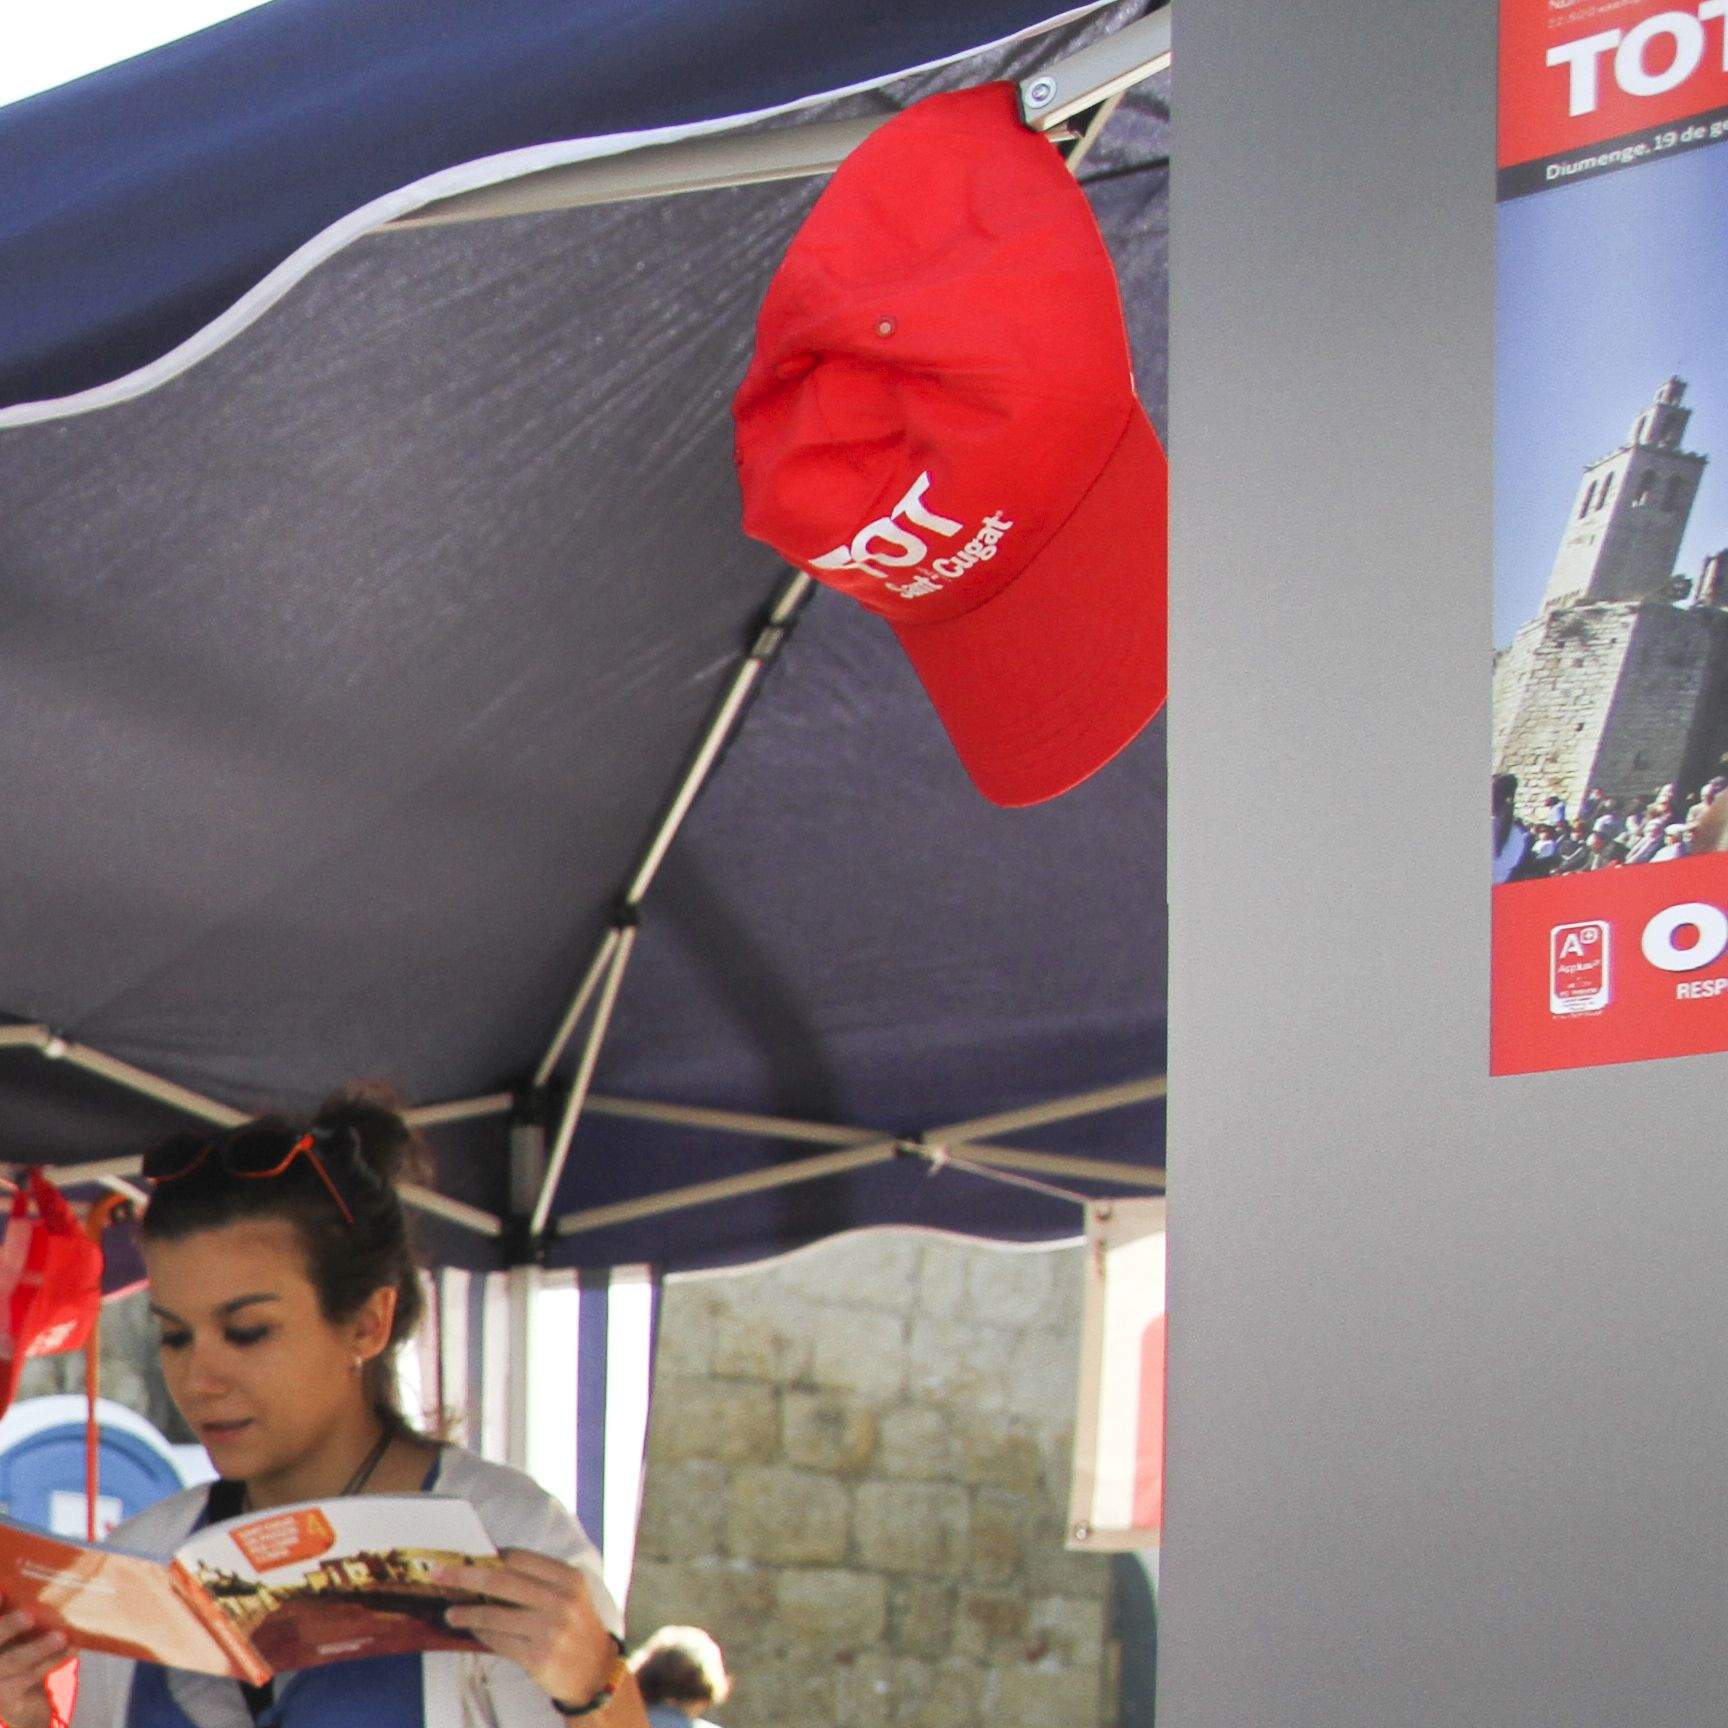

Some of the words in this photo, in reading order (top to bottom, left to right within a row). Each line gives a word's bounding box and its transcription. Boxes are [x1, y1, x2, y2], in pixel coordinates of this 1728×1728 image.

[1654, 132, 1677, 151] 19
[1680, 126, 1707, 143] de
[932, 513, 1014, 579] Cugat
